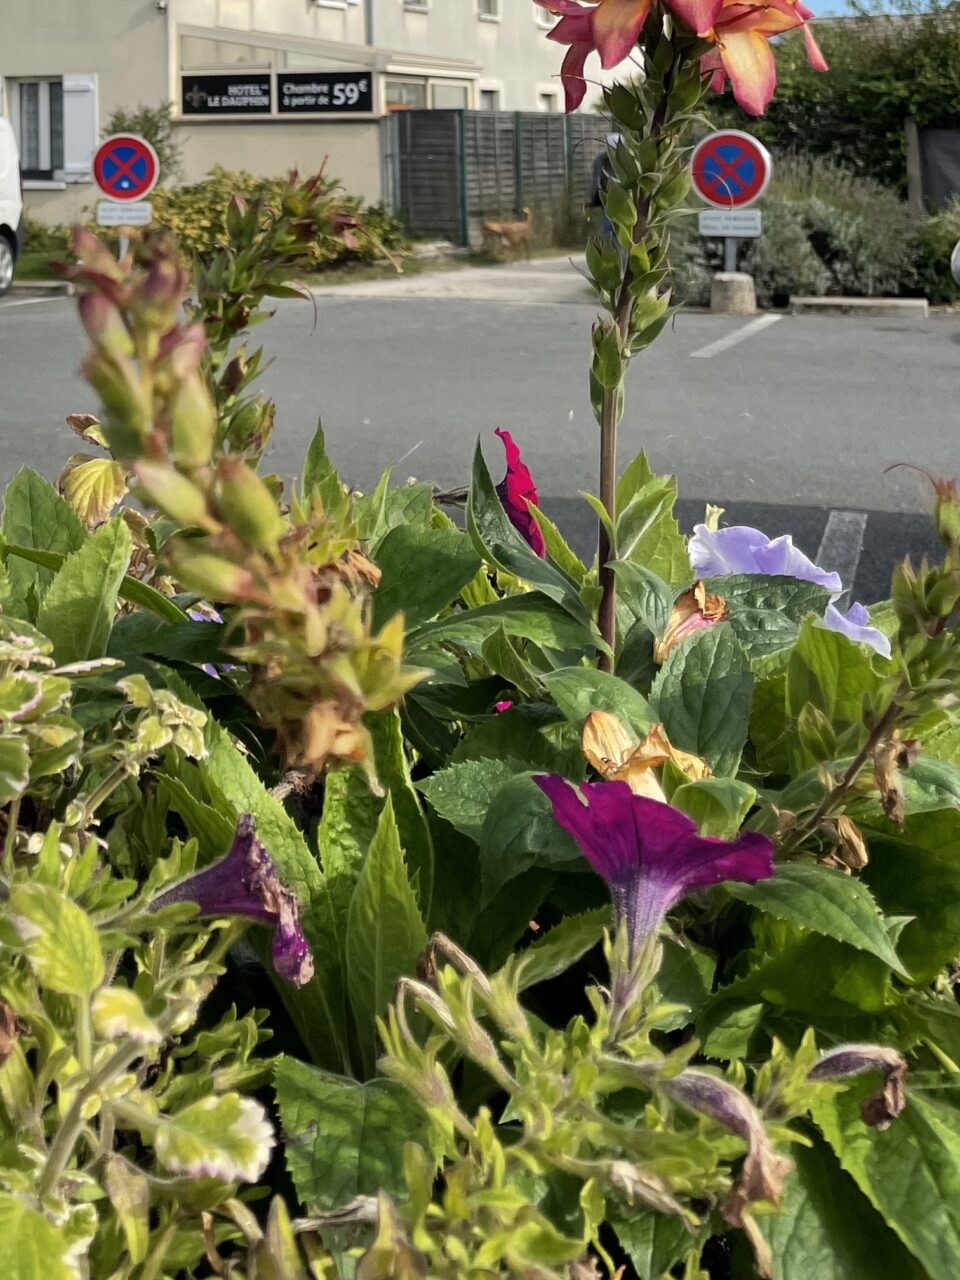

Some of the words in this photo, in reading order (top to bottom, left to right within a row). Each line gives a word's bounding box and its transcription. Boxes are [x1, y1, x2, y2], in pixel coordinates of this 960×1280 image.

[227, 84, 262, 96] HOTEL
[283, 82, 329, 95] Chambre
[207, 95, 220, 107] LE
[221, 95, 269, 107] DAUPHIN
[291, 95, 316, 108] partir
[317, 95, 330, 106] de
